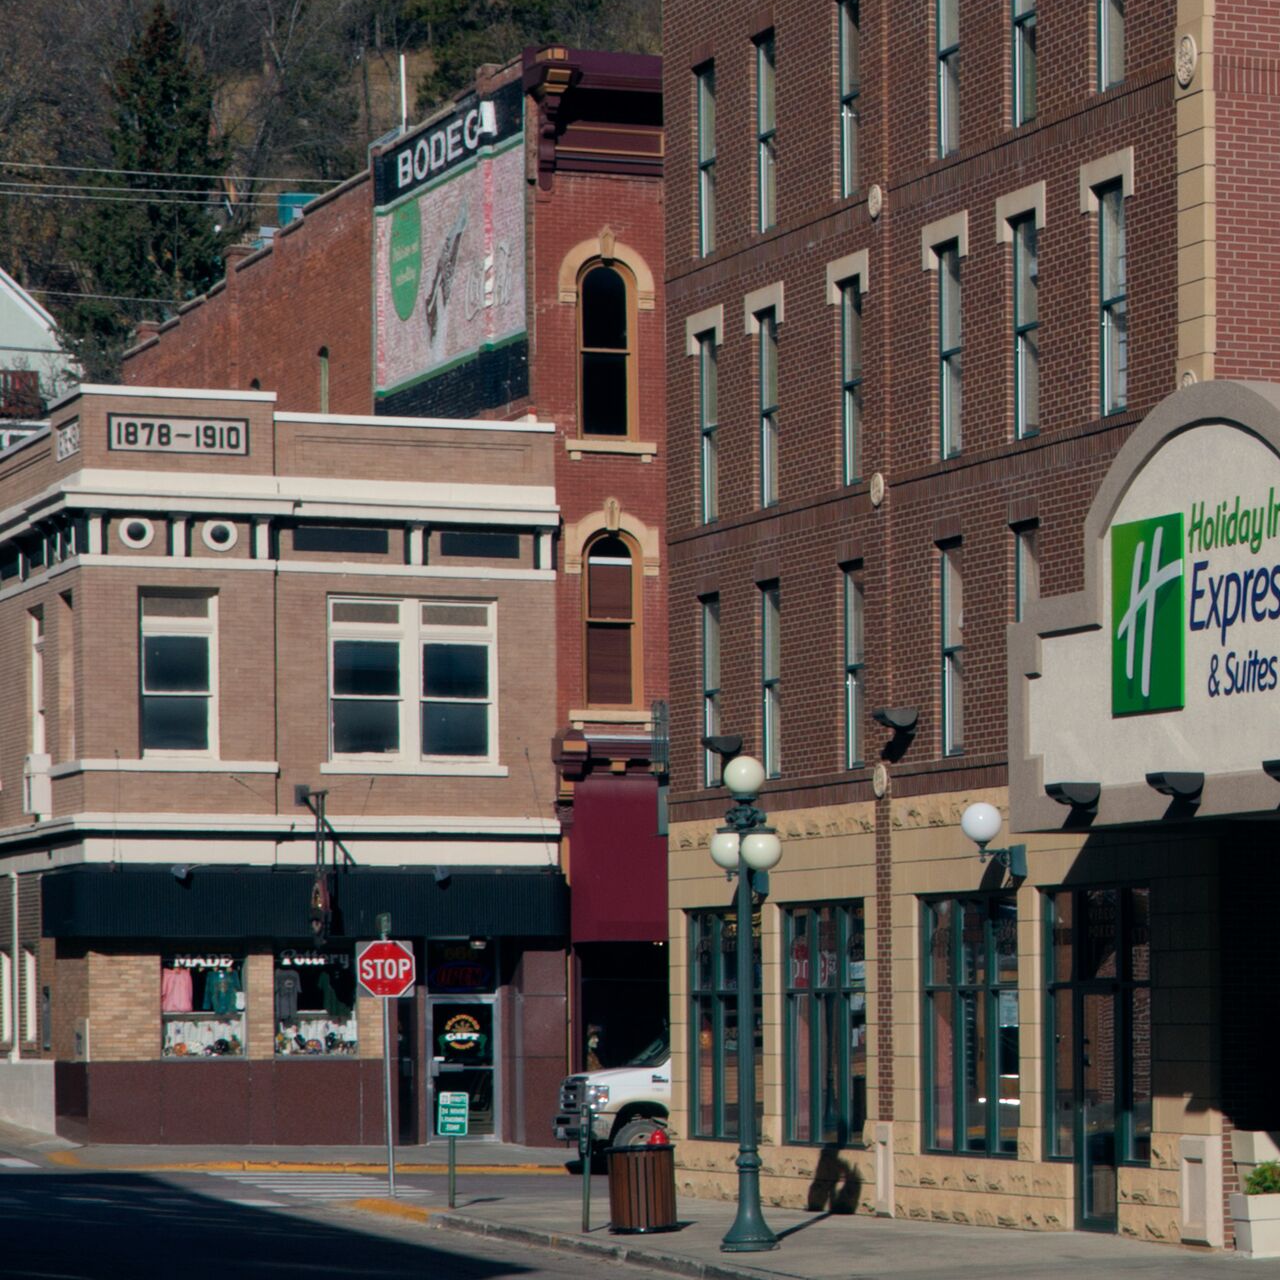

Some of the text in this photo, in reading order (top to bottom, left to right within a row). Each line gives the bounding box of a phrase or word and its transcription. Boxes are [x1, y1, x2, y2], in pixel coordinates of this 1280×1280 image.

[397, 101, 497, 188] BODEGA
[1188, 496, 1265, 554] Holiday
[1208, 650, 1278, 698] & Suites
[174, 954, 233, 967] MADE
[280, 949, 350, 969] Pottery
[361, 959, 411, 980] STOP
[445, 1032, 480, 1041] GIFT
